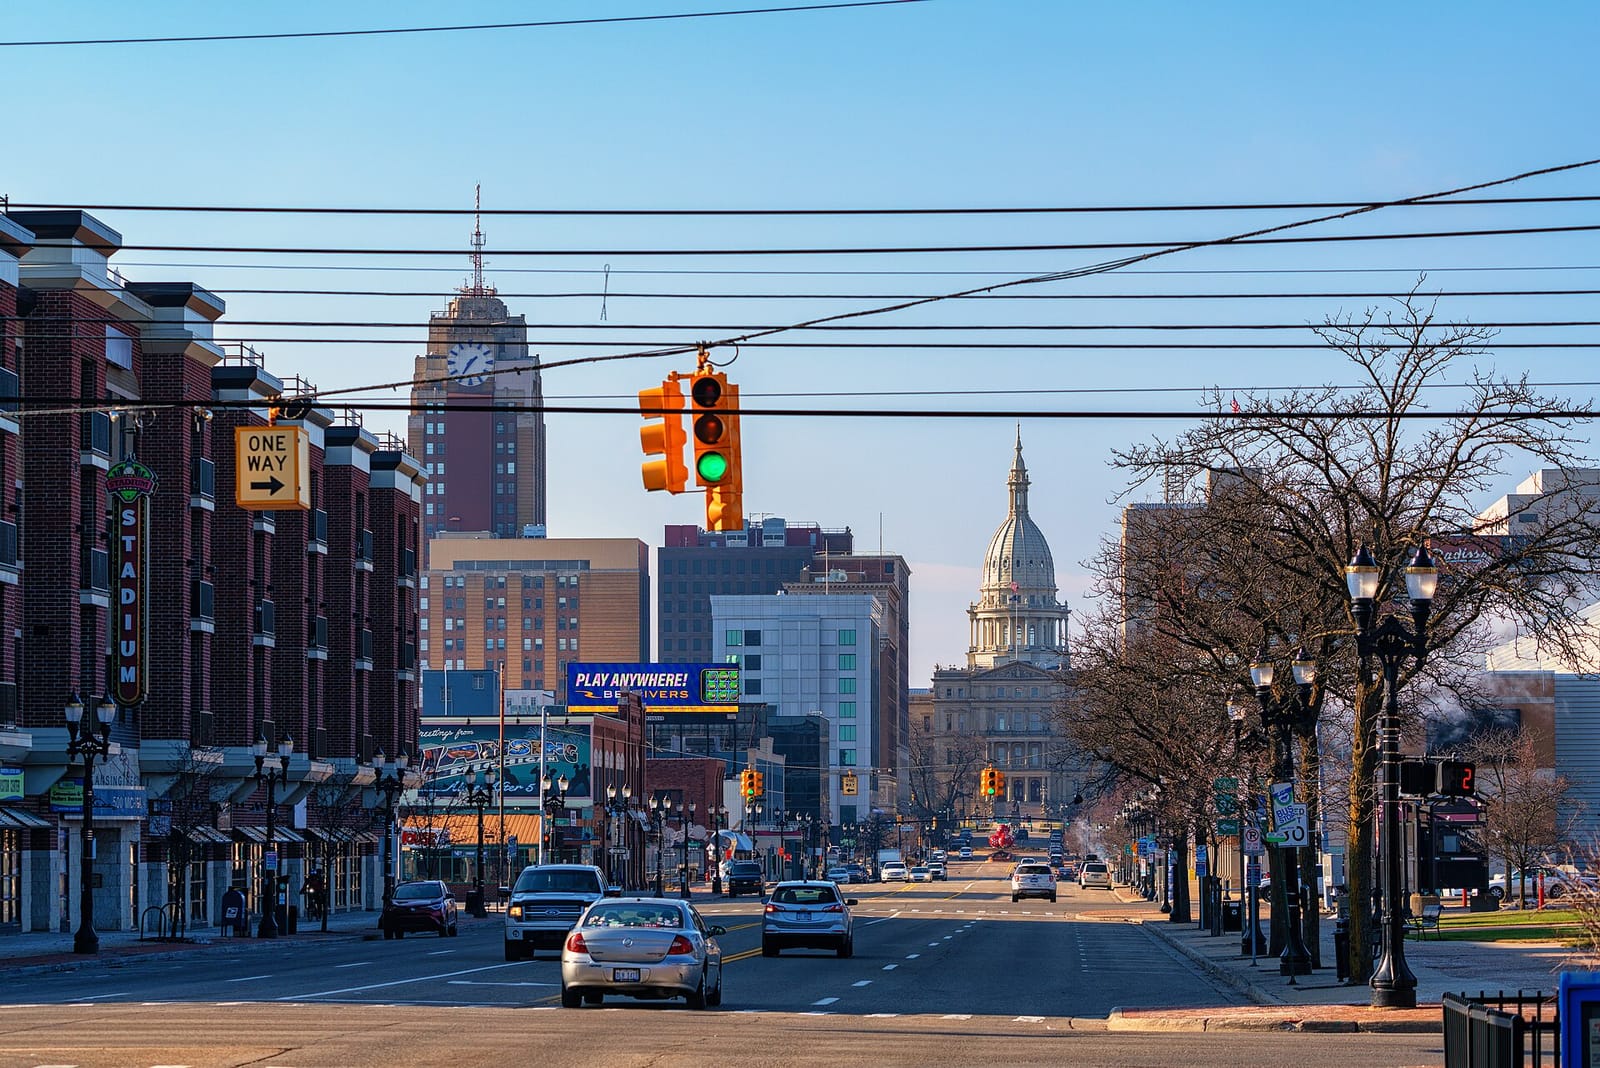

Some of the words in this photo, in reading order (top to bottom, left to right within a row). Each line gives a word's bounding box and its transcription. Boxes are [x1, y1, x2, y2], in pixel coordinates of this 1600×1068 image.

[249, 436, 286, 452] ONE
[247, 455, 287, 471] WAY
[108, 478, 149, 490] STADIUM
[121, 509, 136, 683] STADIUM
[575, 673, 609, 687] PLAY
[610, 673, 688, 687] ANYWHERE!
[603, 690, 689, 699] BEIVERS
[419, 728, 454, 741] reetings
[94, 775, 125, 786] ANSING
[1462, 768, 1472, 790] 2
[525, 782, 537, 792] 5
[1276, 805, 1294, 818] BUS
